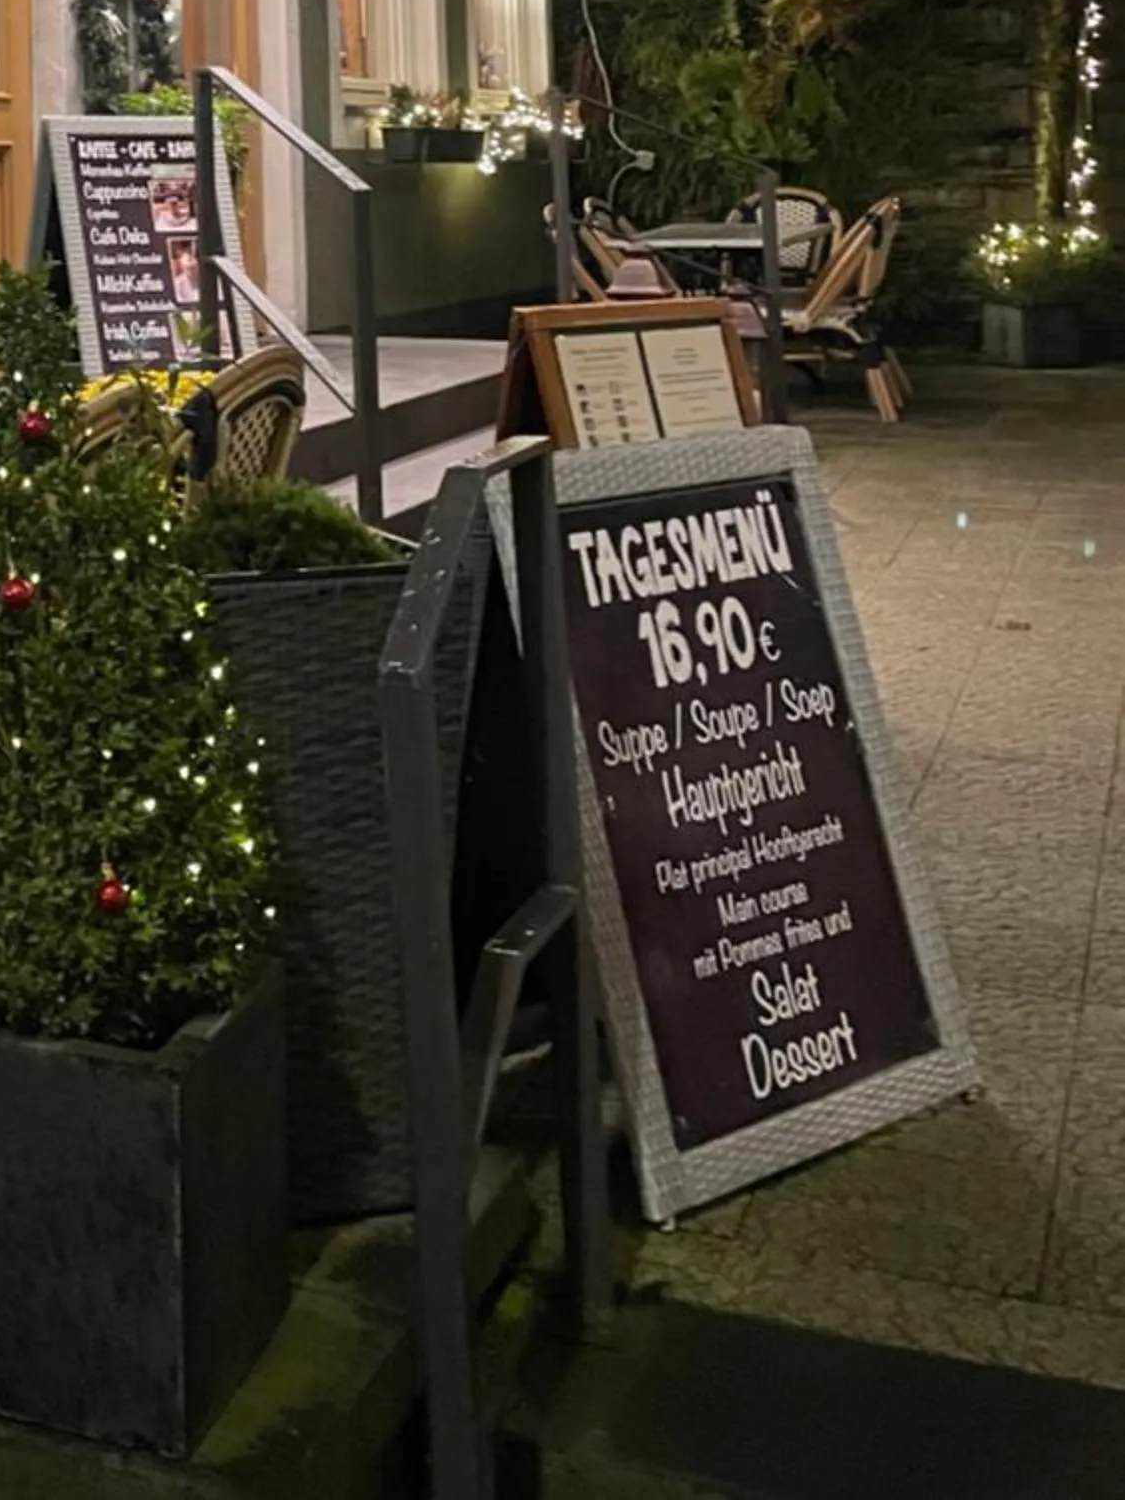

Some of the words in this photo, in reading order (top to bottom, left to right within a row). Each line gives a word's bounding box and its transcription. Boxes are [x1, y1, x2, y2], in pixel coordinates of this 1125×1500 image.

[568, 488, 793, 608] TAGESMENÜ
[597, 719, 670, 776] Suppe
[689, 698, 761, 749] Soupe
[779, 677, 836, 728] Soep
[660, 739, 806, 837] Hauptgericht
[655, 858, 691, 895] Plat
[690, 836, 754, 896] principal
[716, 892, 761, 928] Main
[717, 937, 785, 972] Pommes
[823, 899, 854, 937] und
[751, 960, 821, 1028] Salat
[740, 1011, 858, 1100] Dessert
